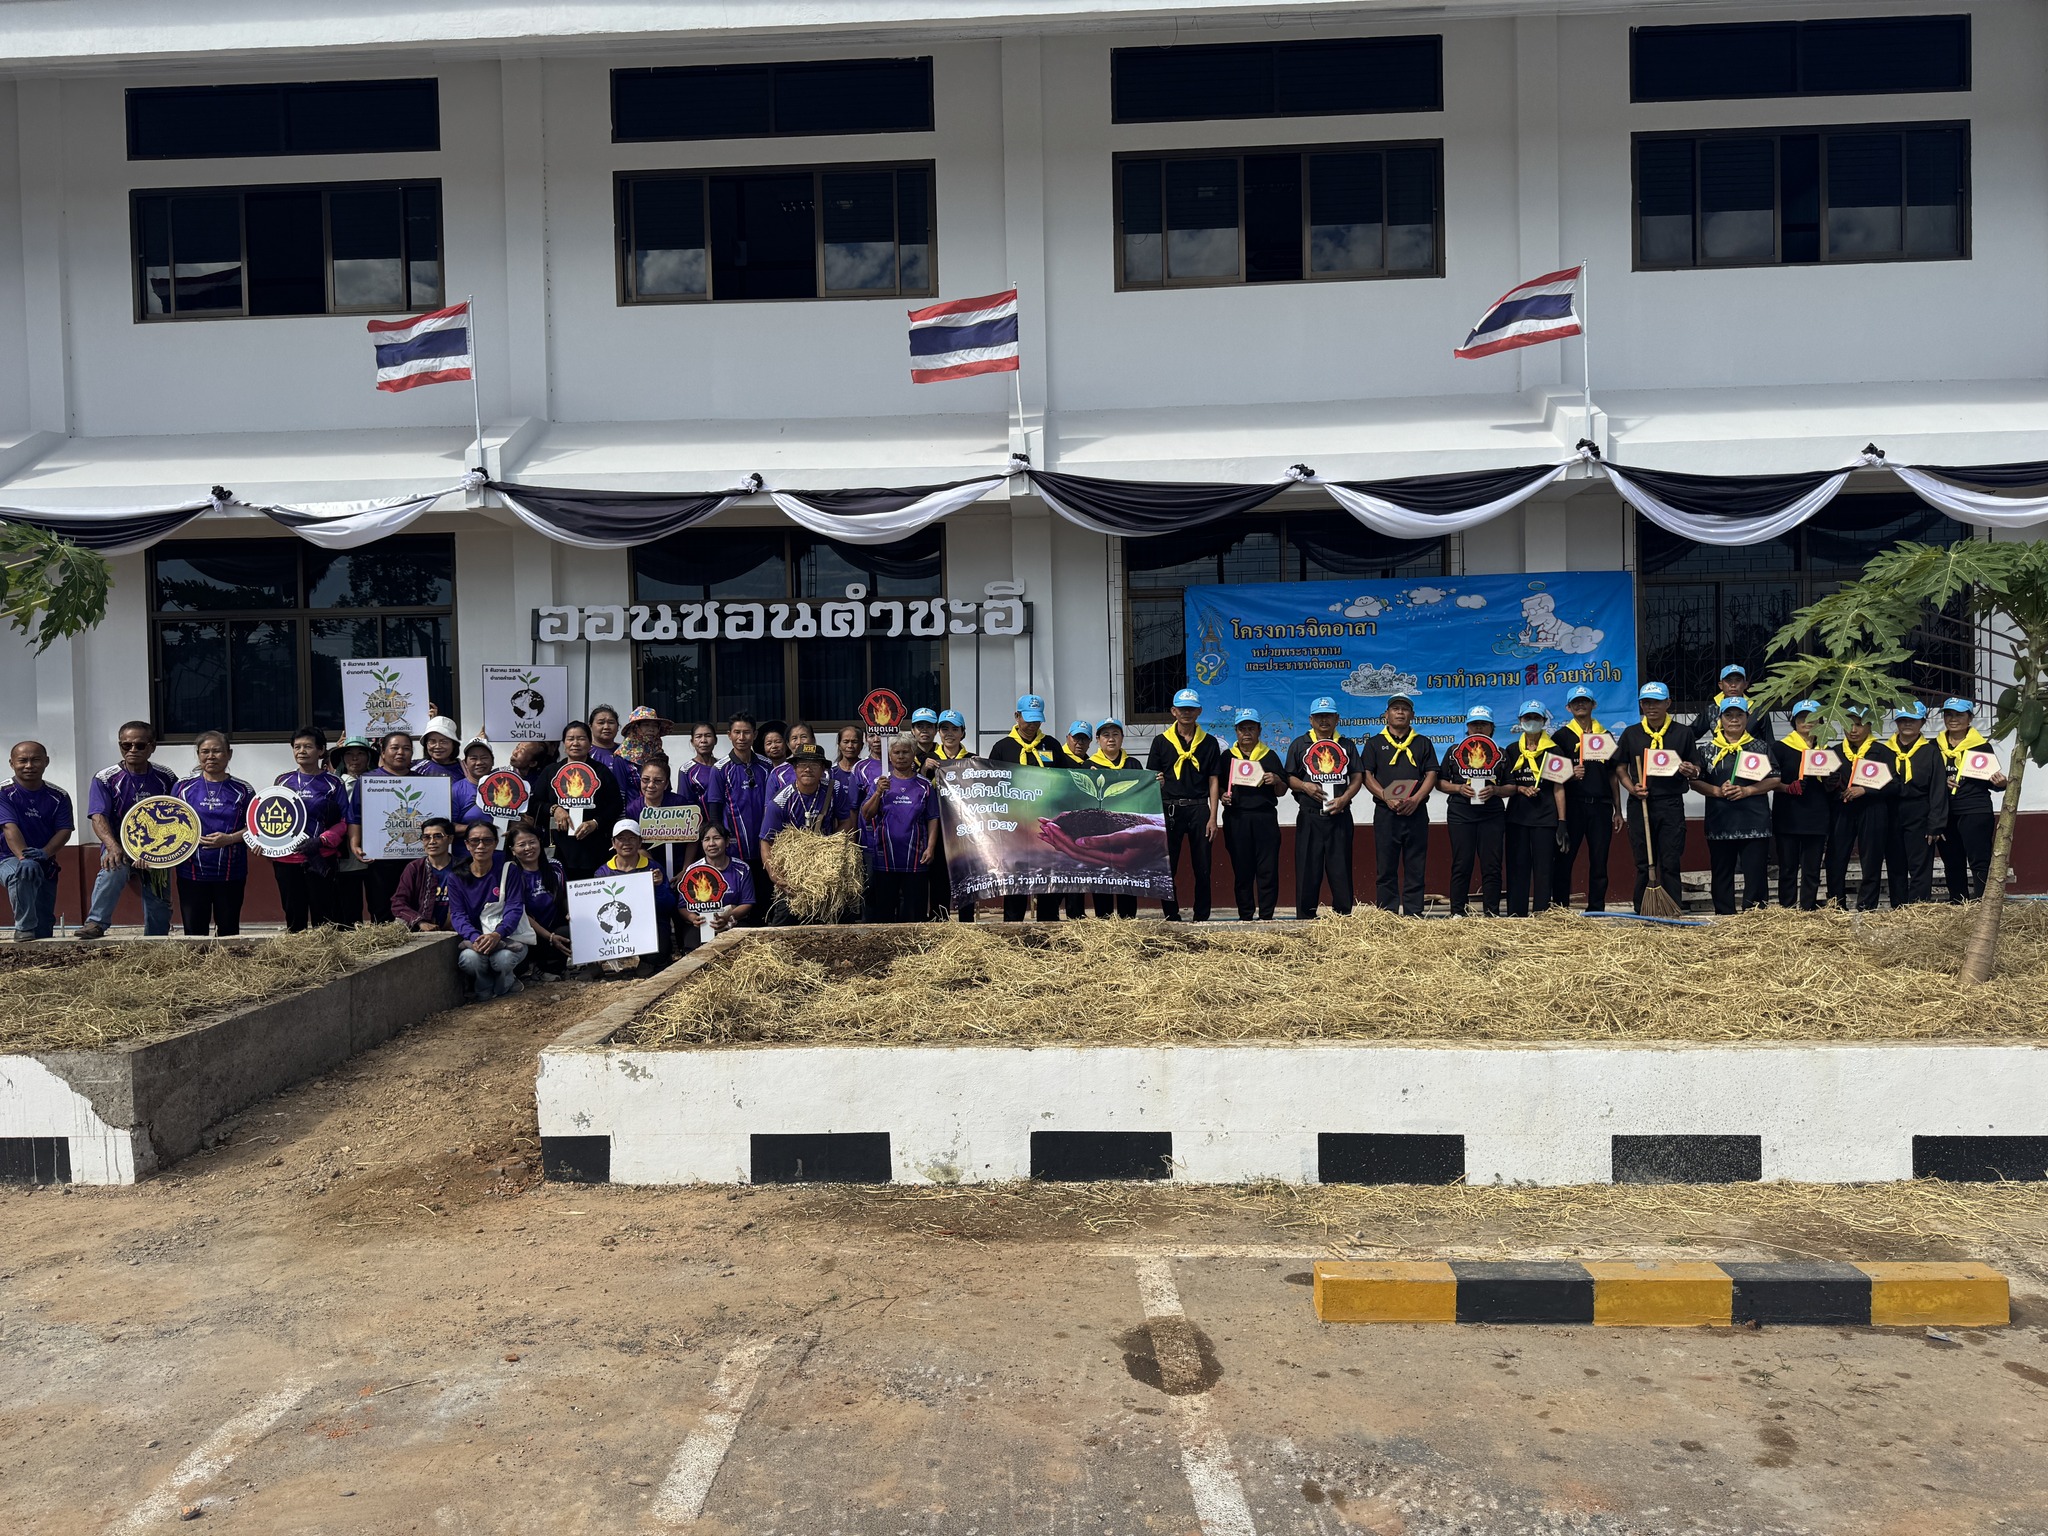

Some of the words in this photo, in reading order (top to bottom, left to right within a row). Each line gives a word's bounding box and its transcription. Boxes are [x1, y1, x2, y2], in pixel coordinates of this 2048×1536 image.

[539, 577, 1025, 641] ออนซอนคำชะอี
[1230, 617, 1377, 640] โครงการจิตอาสา
[1251, 645, 1341, 658] หน่วยพระราชทาน
[1245, 659, 1351, 672] และประชาชนจิตอาสา
[1427, 668, 1520, 688] เราทำความ
[1525, 664, 1539, 687] ดี
[1543, 660, 1622, 685] ด้วยหัวใจ
[515, 721, 541, 729] World
[869, 726, 899, 735] หยุดเผา
[510, 730, 527, 738] Soil
[529, 730, 546, 740] Day
[946, 771, 956, 781] 5
[962, 768, 1012, 780] ธันวาคม
[1312, 773, 1342, 782] หยุดเผา
[1461, 769, 1492, 777] หยุดเผา
[560, 797, 591, 807] หยุดเผา
[484, 805, 517, 817] หยุดเผา
[642, 807, 692, 824] หยุดเผา
[385, 818, 422, 828] วันดินโล
[988, 820, 1018, 832] Day
[143, 843, 189, 863] กรมการปกครอง
[1018, 874, 1048, 886] ร่วมกับ
[689, 902, 720, 911] หยุดเผา
[602, 934, 629, 946] World
[598, 947, 615, 957] Soil
[617, 945, 635, 955] Day
